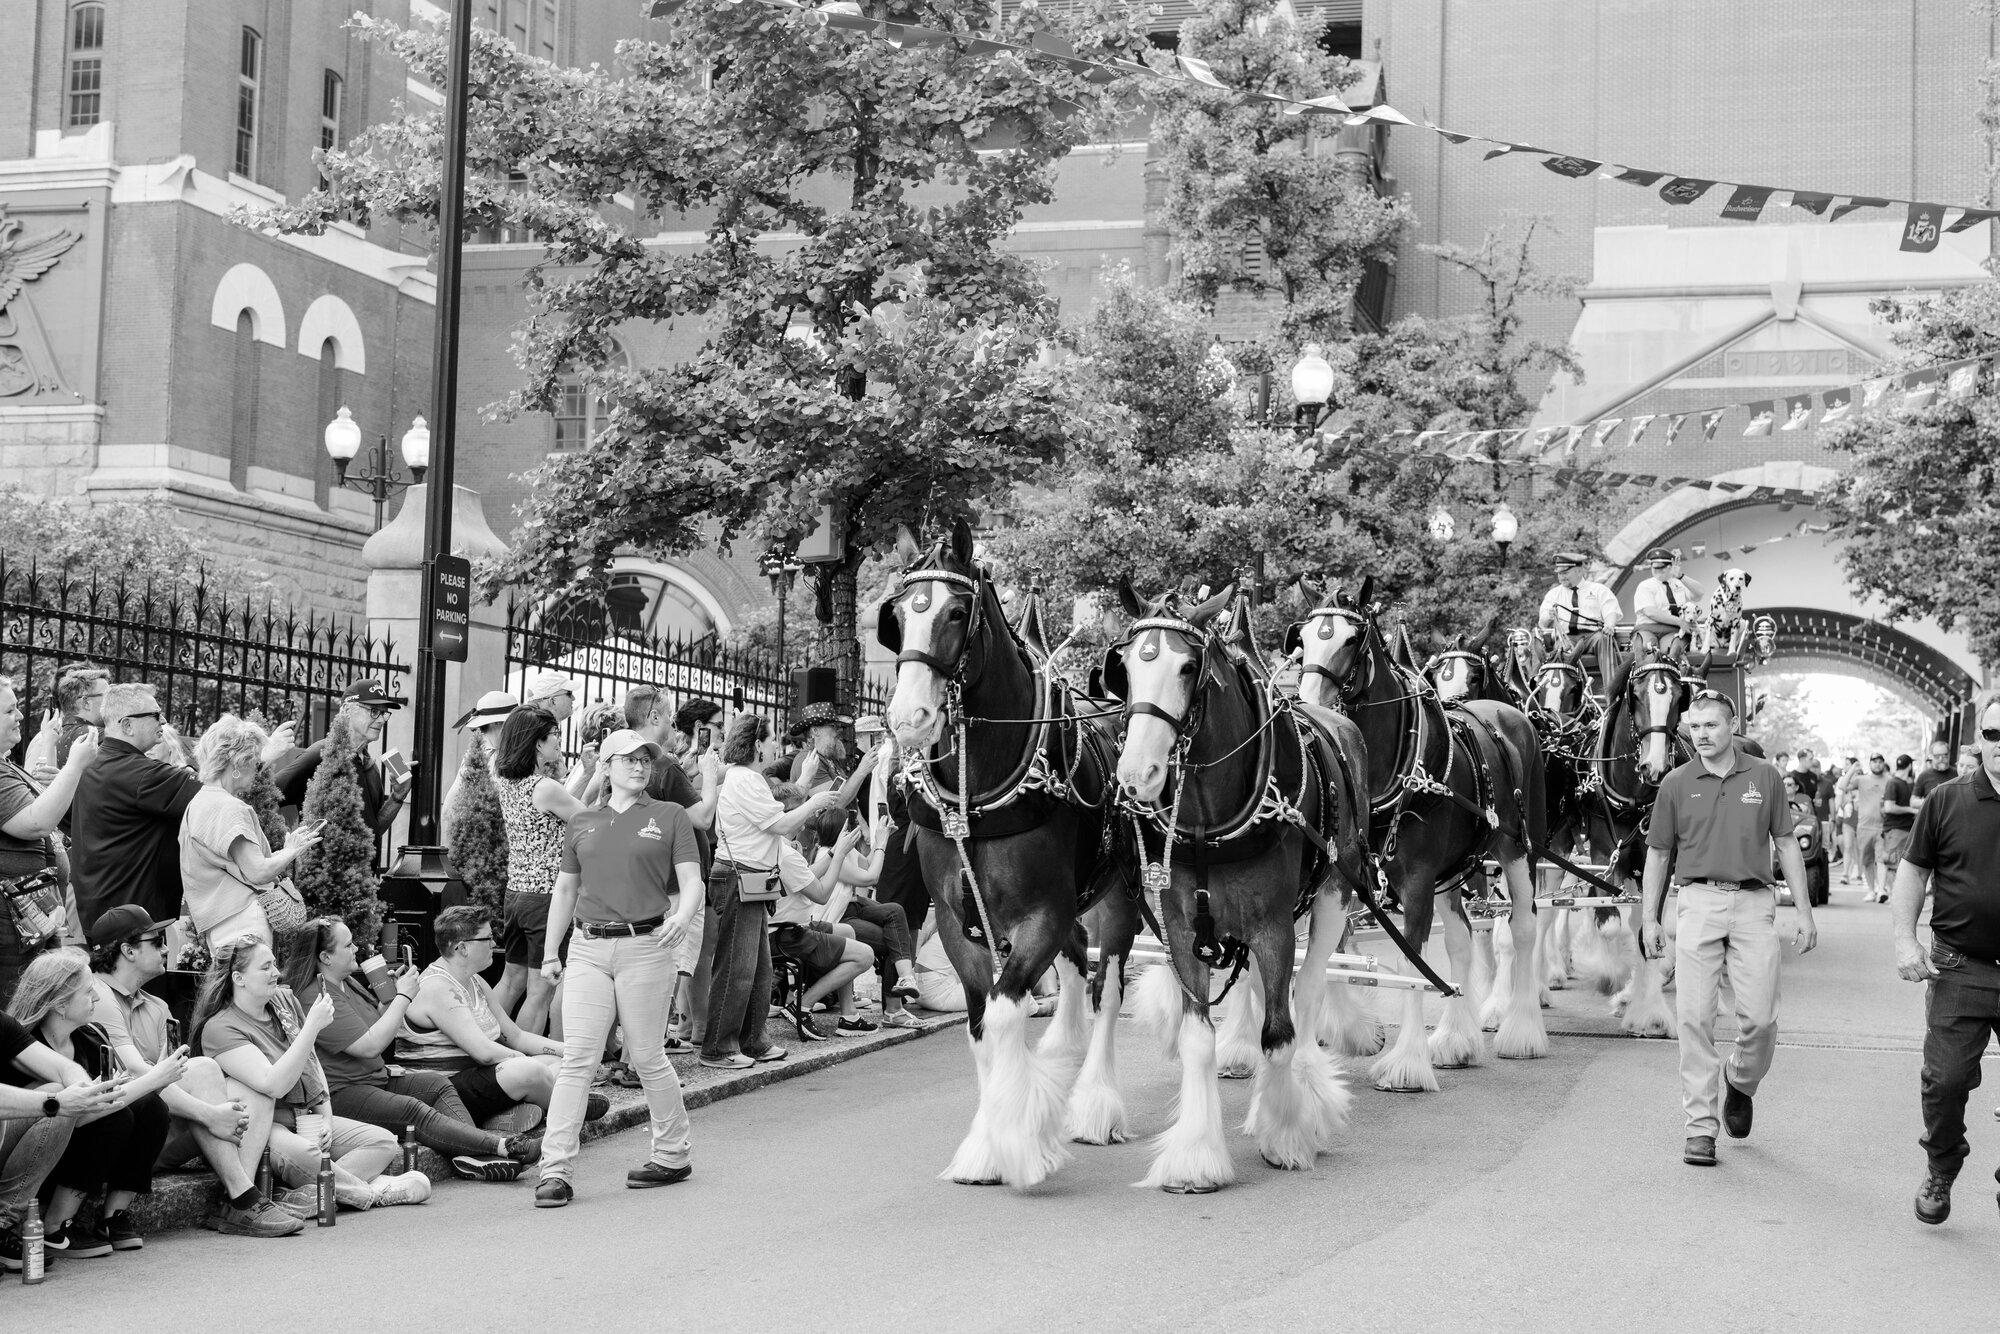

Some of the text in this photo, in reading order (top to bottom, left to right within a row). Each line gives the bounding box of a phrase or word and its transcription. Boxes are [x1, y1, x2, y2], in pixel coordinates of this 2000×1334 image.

[1907, 220, 1936, 244] 150
[440, 572, 465, 588] PLEASE
[446, 592, 458, 605] NO
[436, 608, 467, 625] PARKING
